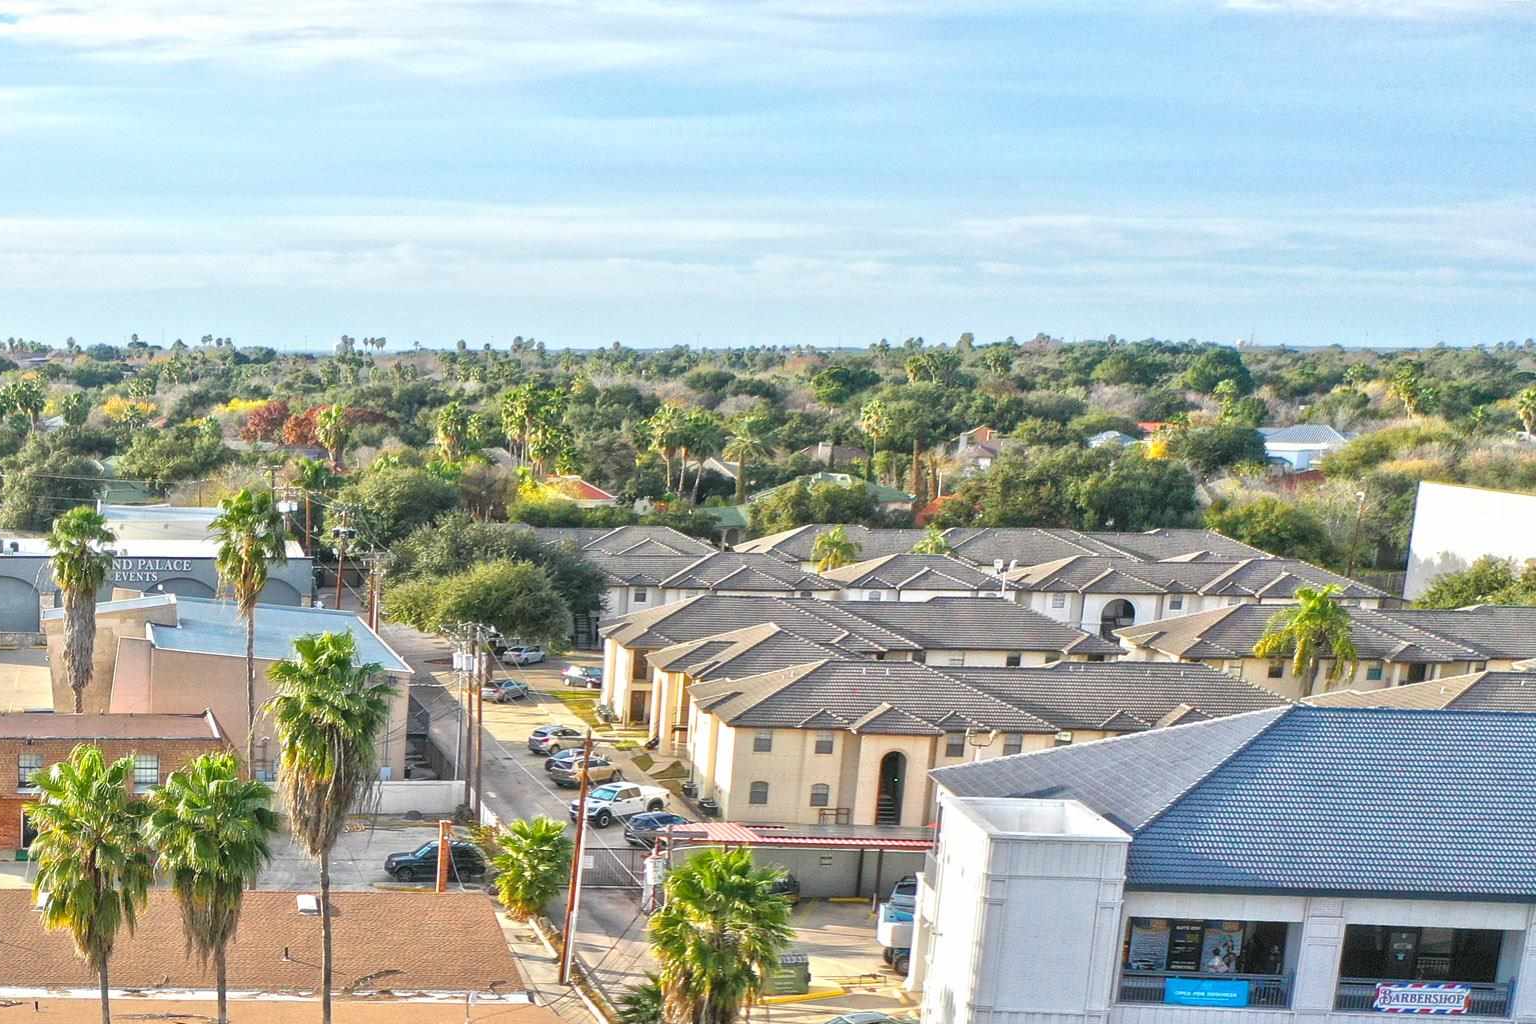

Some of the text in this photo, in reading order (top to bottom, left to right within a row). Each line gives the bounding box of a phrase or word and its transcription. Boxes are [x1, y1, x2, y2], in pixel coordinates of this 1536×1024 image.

[138, 559, 192, 570] PALACE
[115, 571, 158, 581] EVENTS
[1378, 988, 1465, 1006] BARBERSHOP
